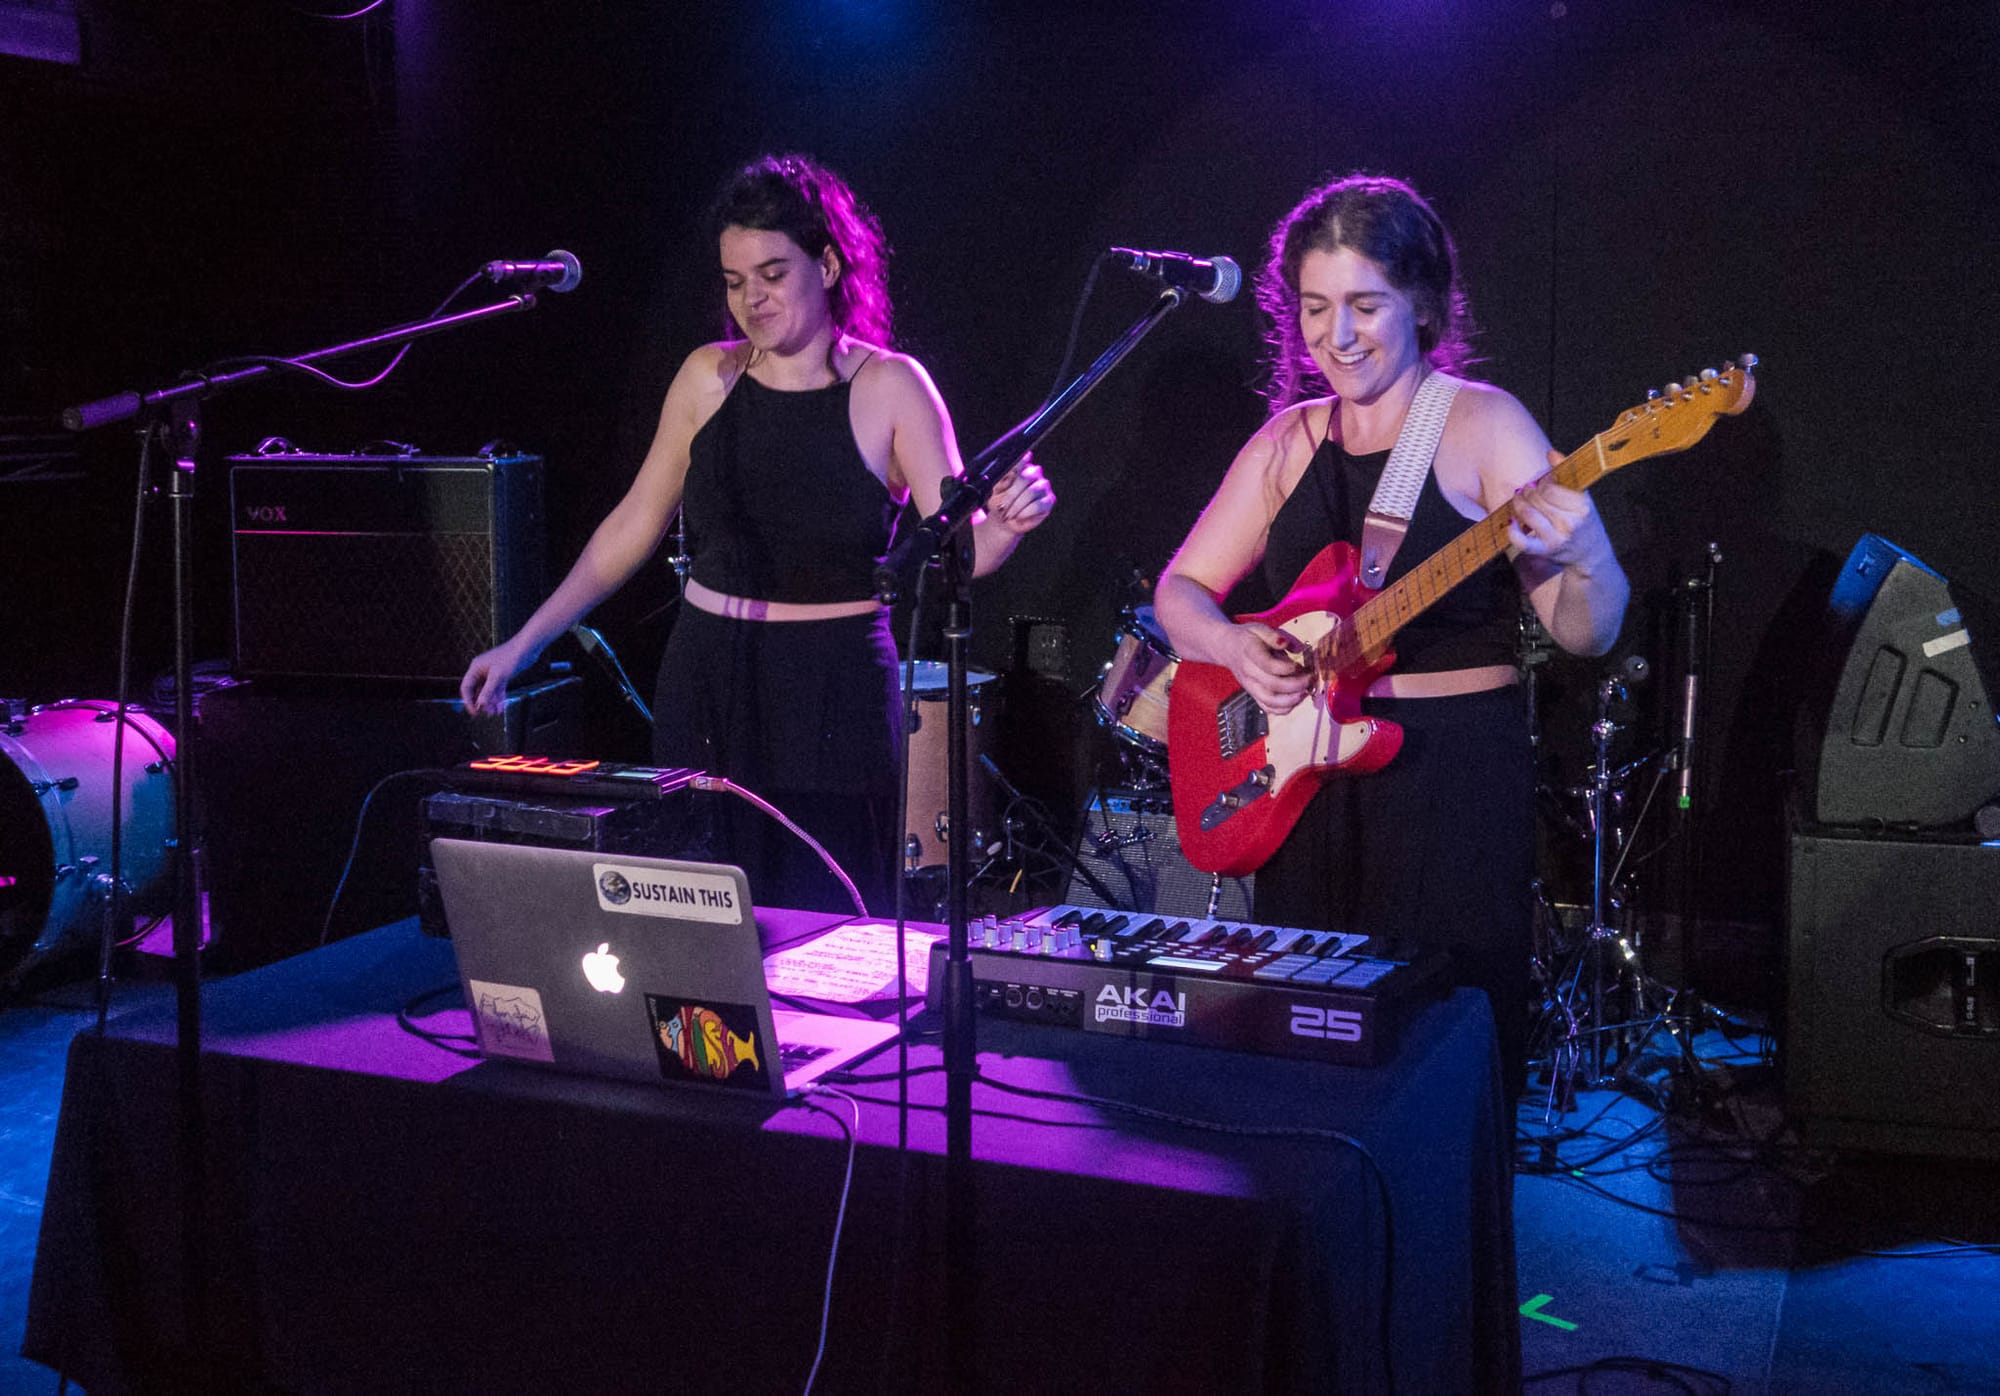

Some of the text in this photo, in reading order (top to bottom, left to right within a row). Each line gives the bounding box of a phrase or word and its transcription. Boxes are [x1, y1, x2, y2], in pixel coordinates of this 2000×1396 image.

[244, 504, 288, 521] VOX
[632, 881, 734, 909] SUSTAIN THIS
[1095, 984, 1187, 1012] AKAI
[1097, 1007, 1183, 1025] professional
[1290, 1005, 1363, 1042] 25
